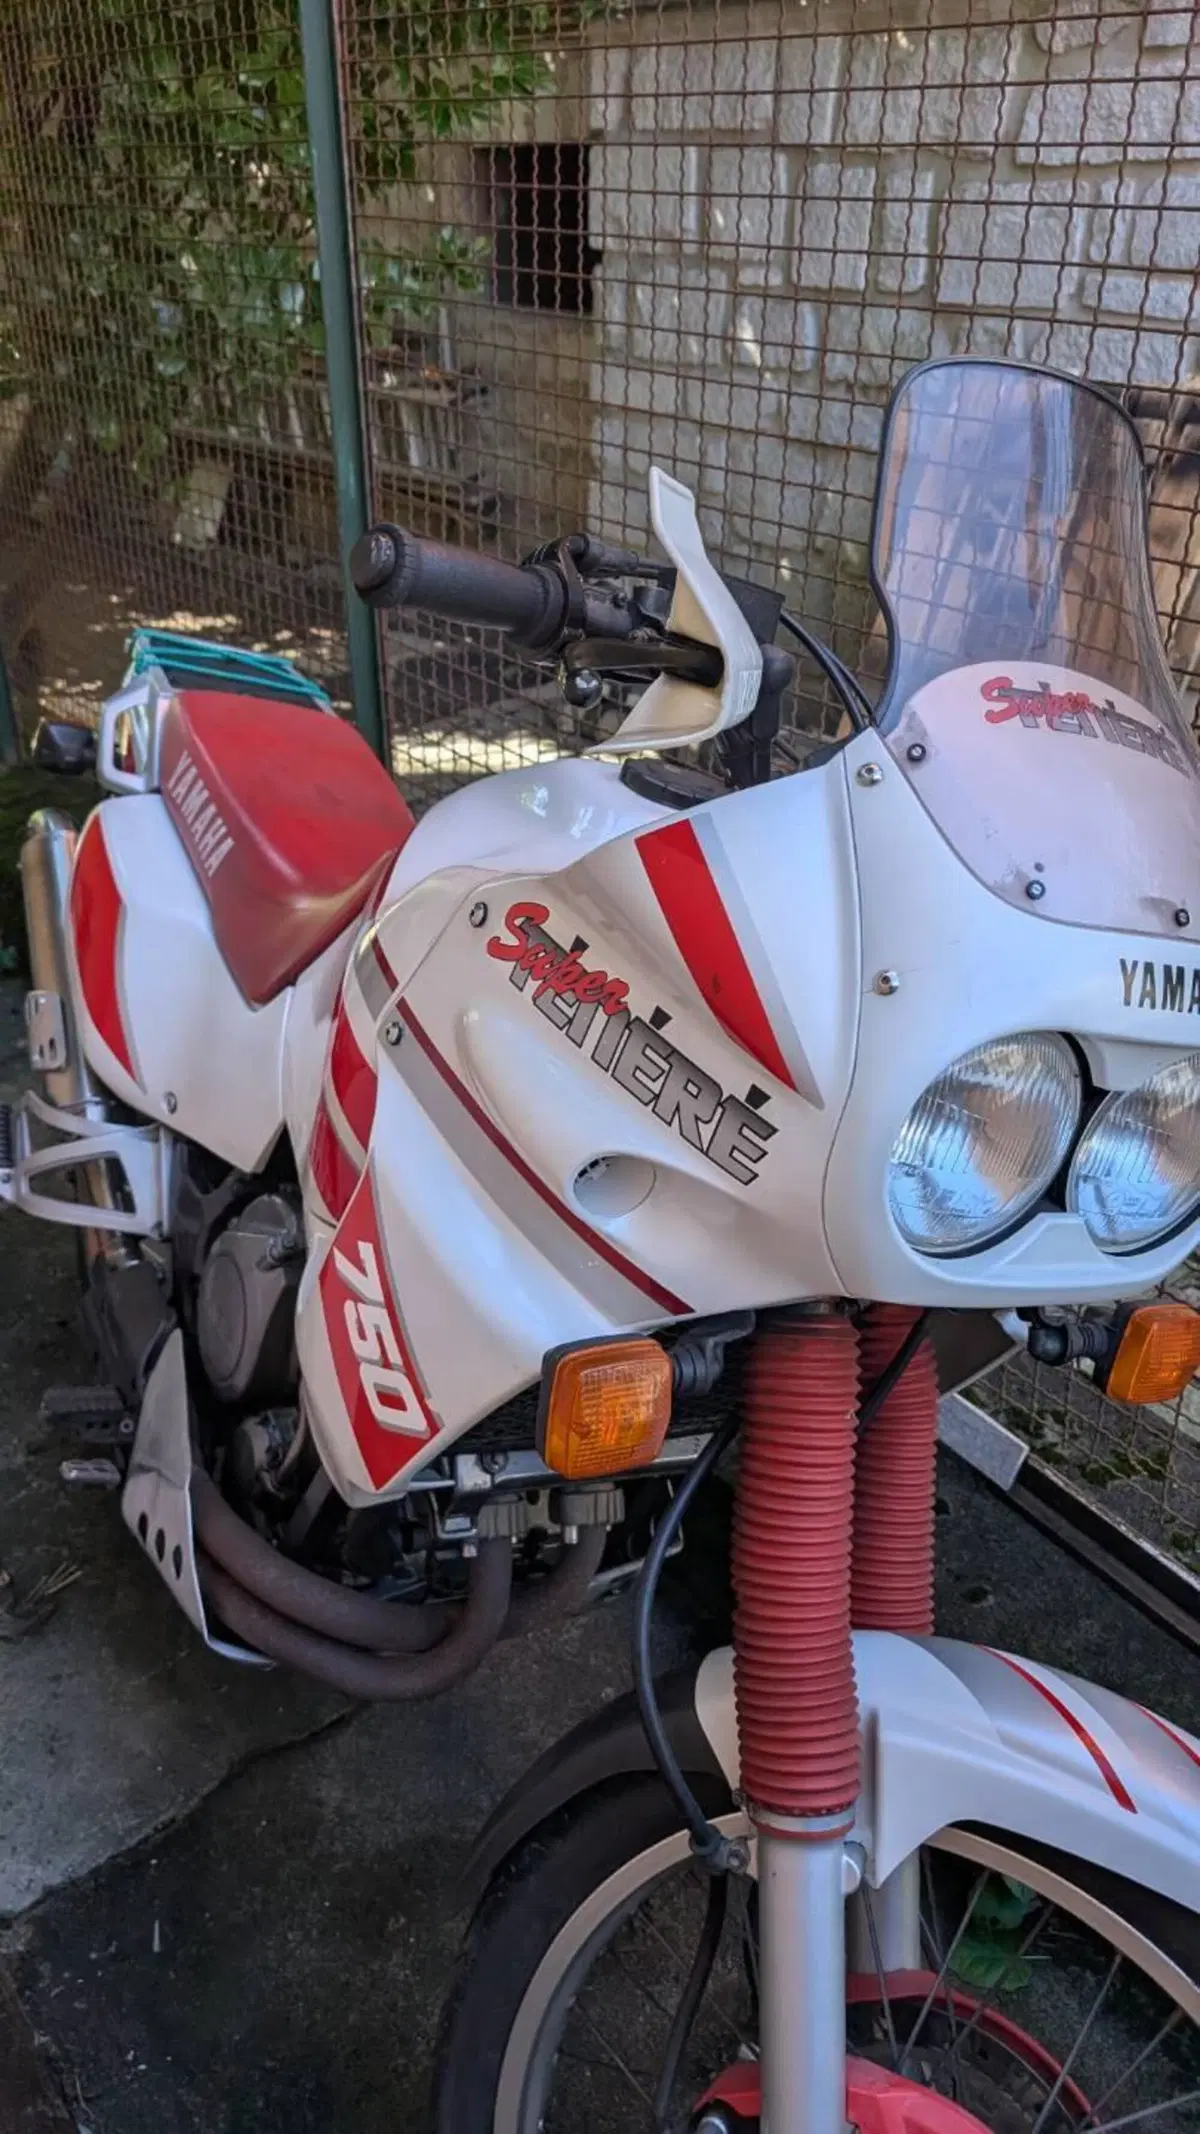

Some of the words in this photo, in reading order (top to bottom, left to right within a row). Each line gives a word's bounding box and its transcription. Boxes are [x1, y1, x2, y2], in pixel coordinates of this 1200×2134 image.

[167, 749, 235, 878] YAMAHA
[487, 902, 630, 1017] Super
[333, 1240, 431, 1440] 750
